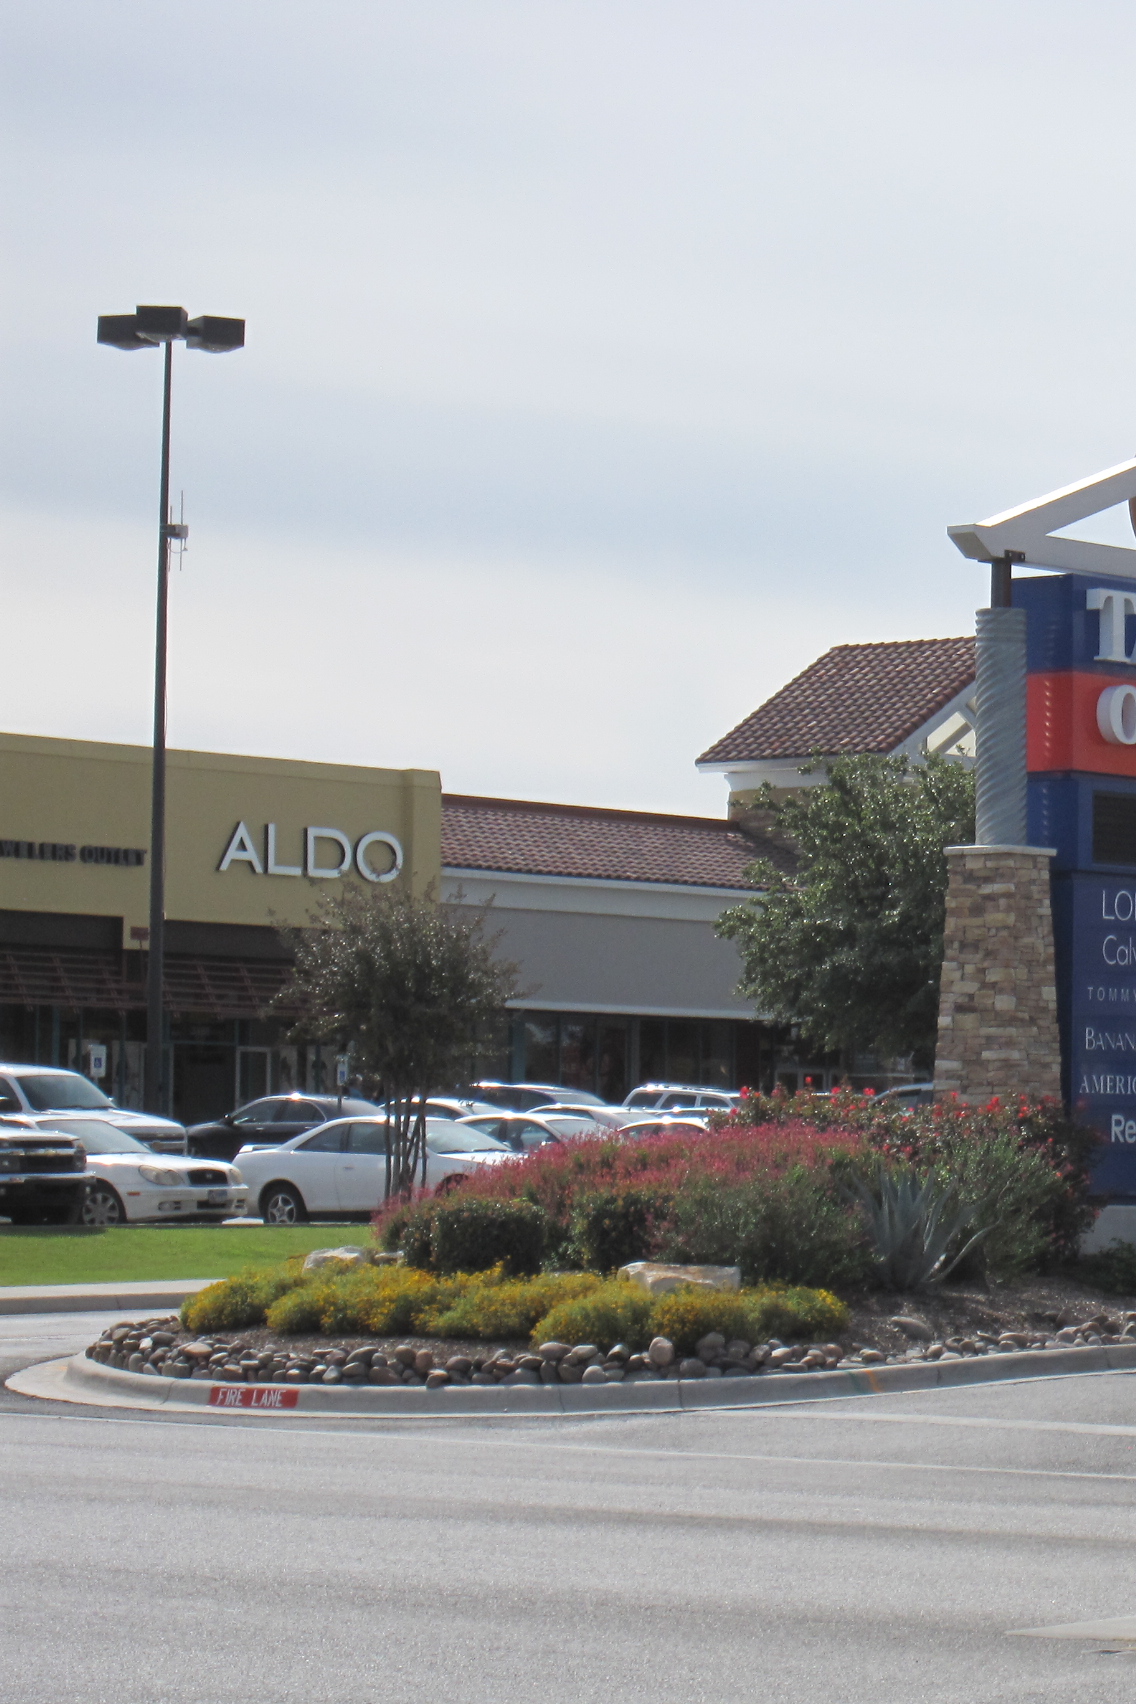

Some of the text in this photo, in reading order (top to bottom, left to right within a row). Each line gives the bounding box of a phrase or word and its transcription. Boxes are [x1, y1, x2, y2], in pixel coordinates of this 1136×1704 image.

[80, 845, 147, 867] OUTLET
[218, 820, 403, 883] ALDO
[217, 1388, 287, 1408] FIRE LANE
